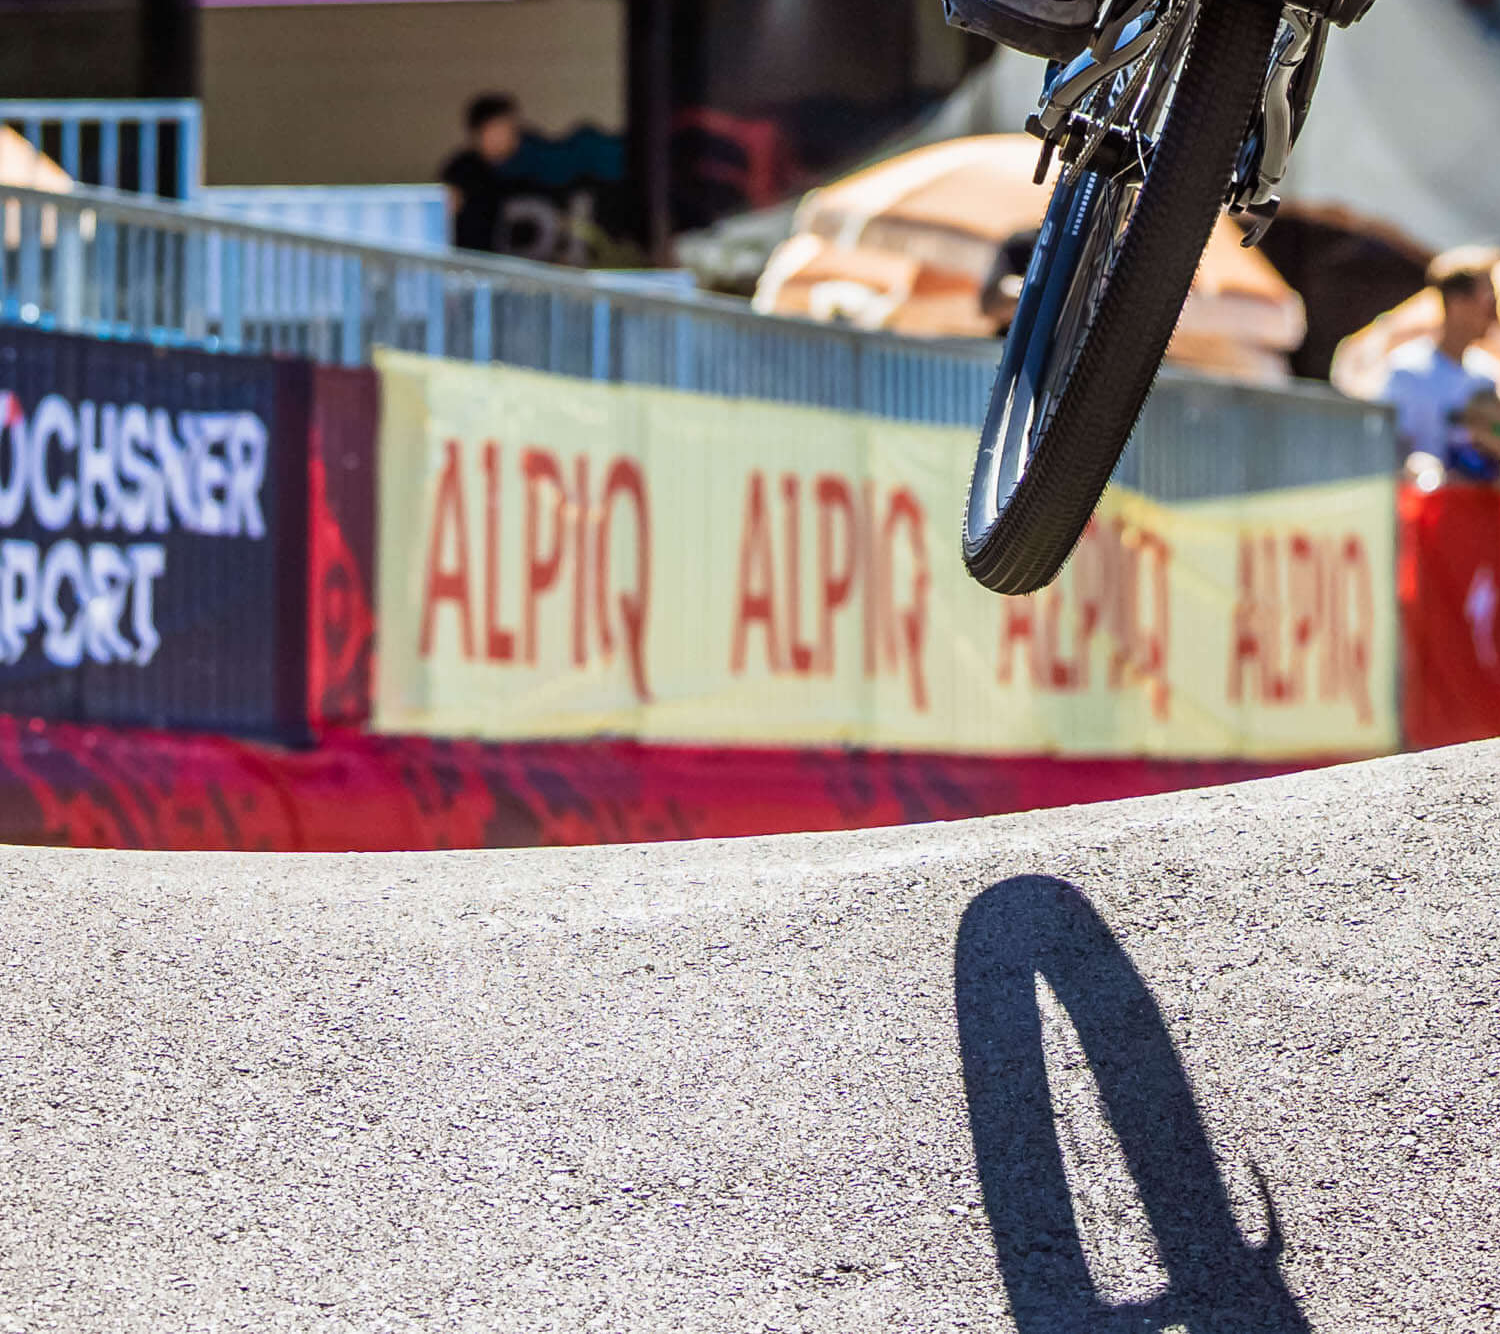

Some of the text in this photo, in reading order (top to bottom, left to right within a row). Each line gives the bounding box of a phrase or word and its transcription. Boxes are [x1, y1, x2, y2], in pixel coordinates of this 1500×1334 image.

[419, 438, 654, 703] ALPIQ
[731, 469, 929, 712] ALPIQ
[1227, 533, 1375, 725] ALPIQ
